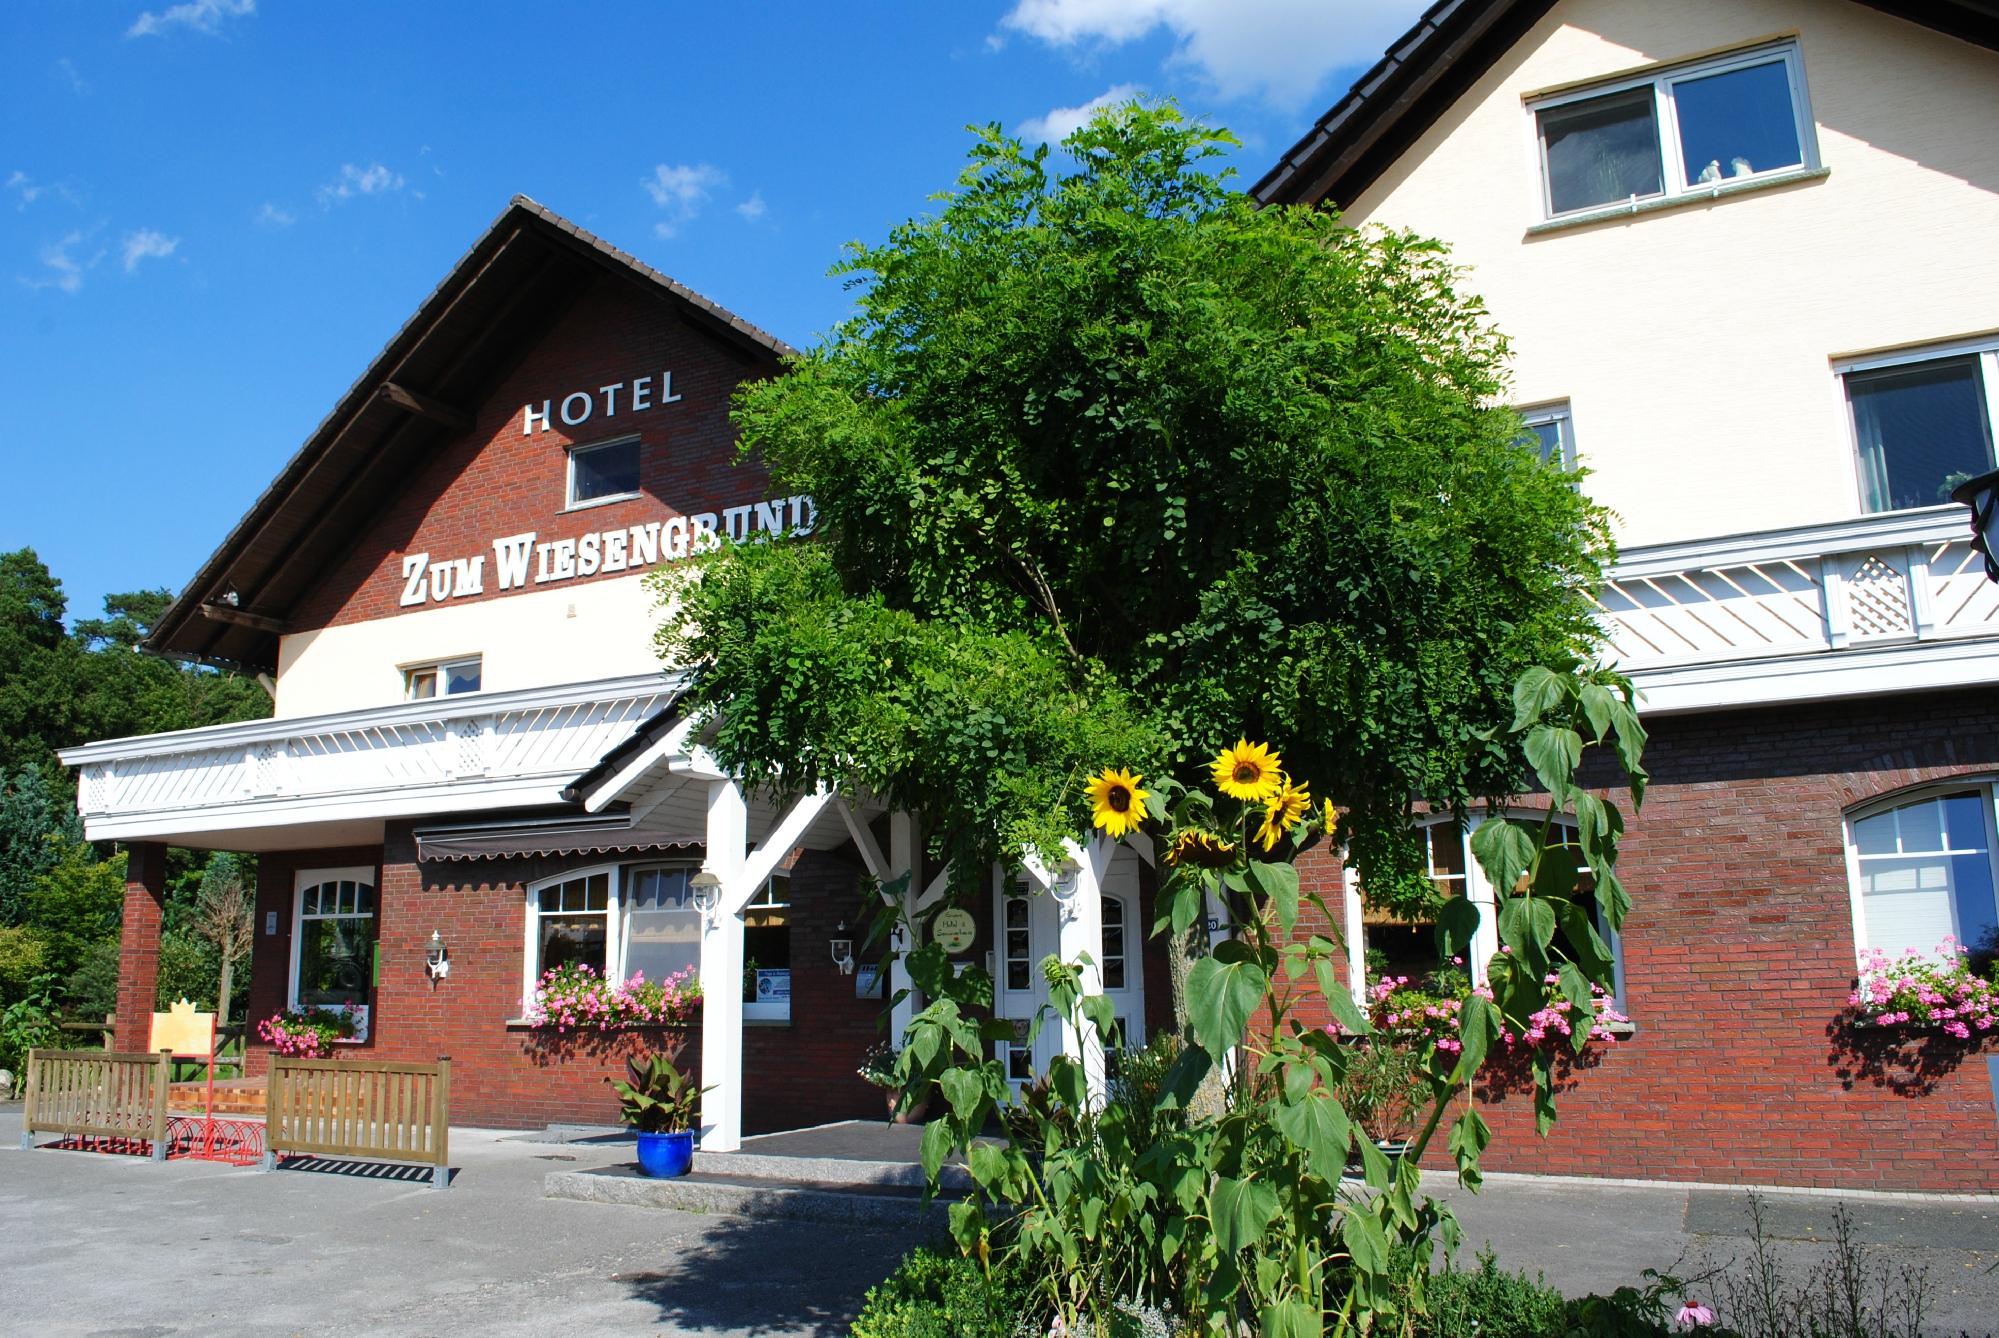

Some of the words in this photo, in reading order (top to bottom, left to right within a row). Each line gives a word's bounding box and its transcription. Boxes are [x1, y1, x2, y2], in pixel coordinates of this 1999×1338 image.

[523, 371, 682, 436] HOTEL
[400, 553, 485, 607] ZUM
[492, 494, 819, 590] WIESENGRUND
